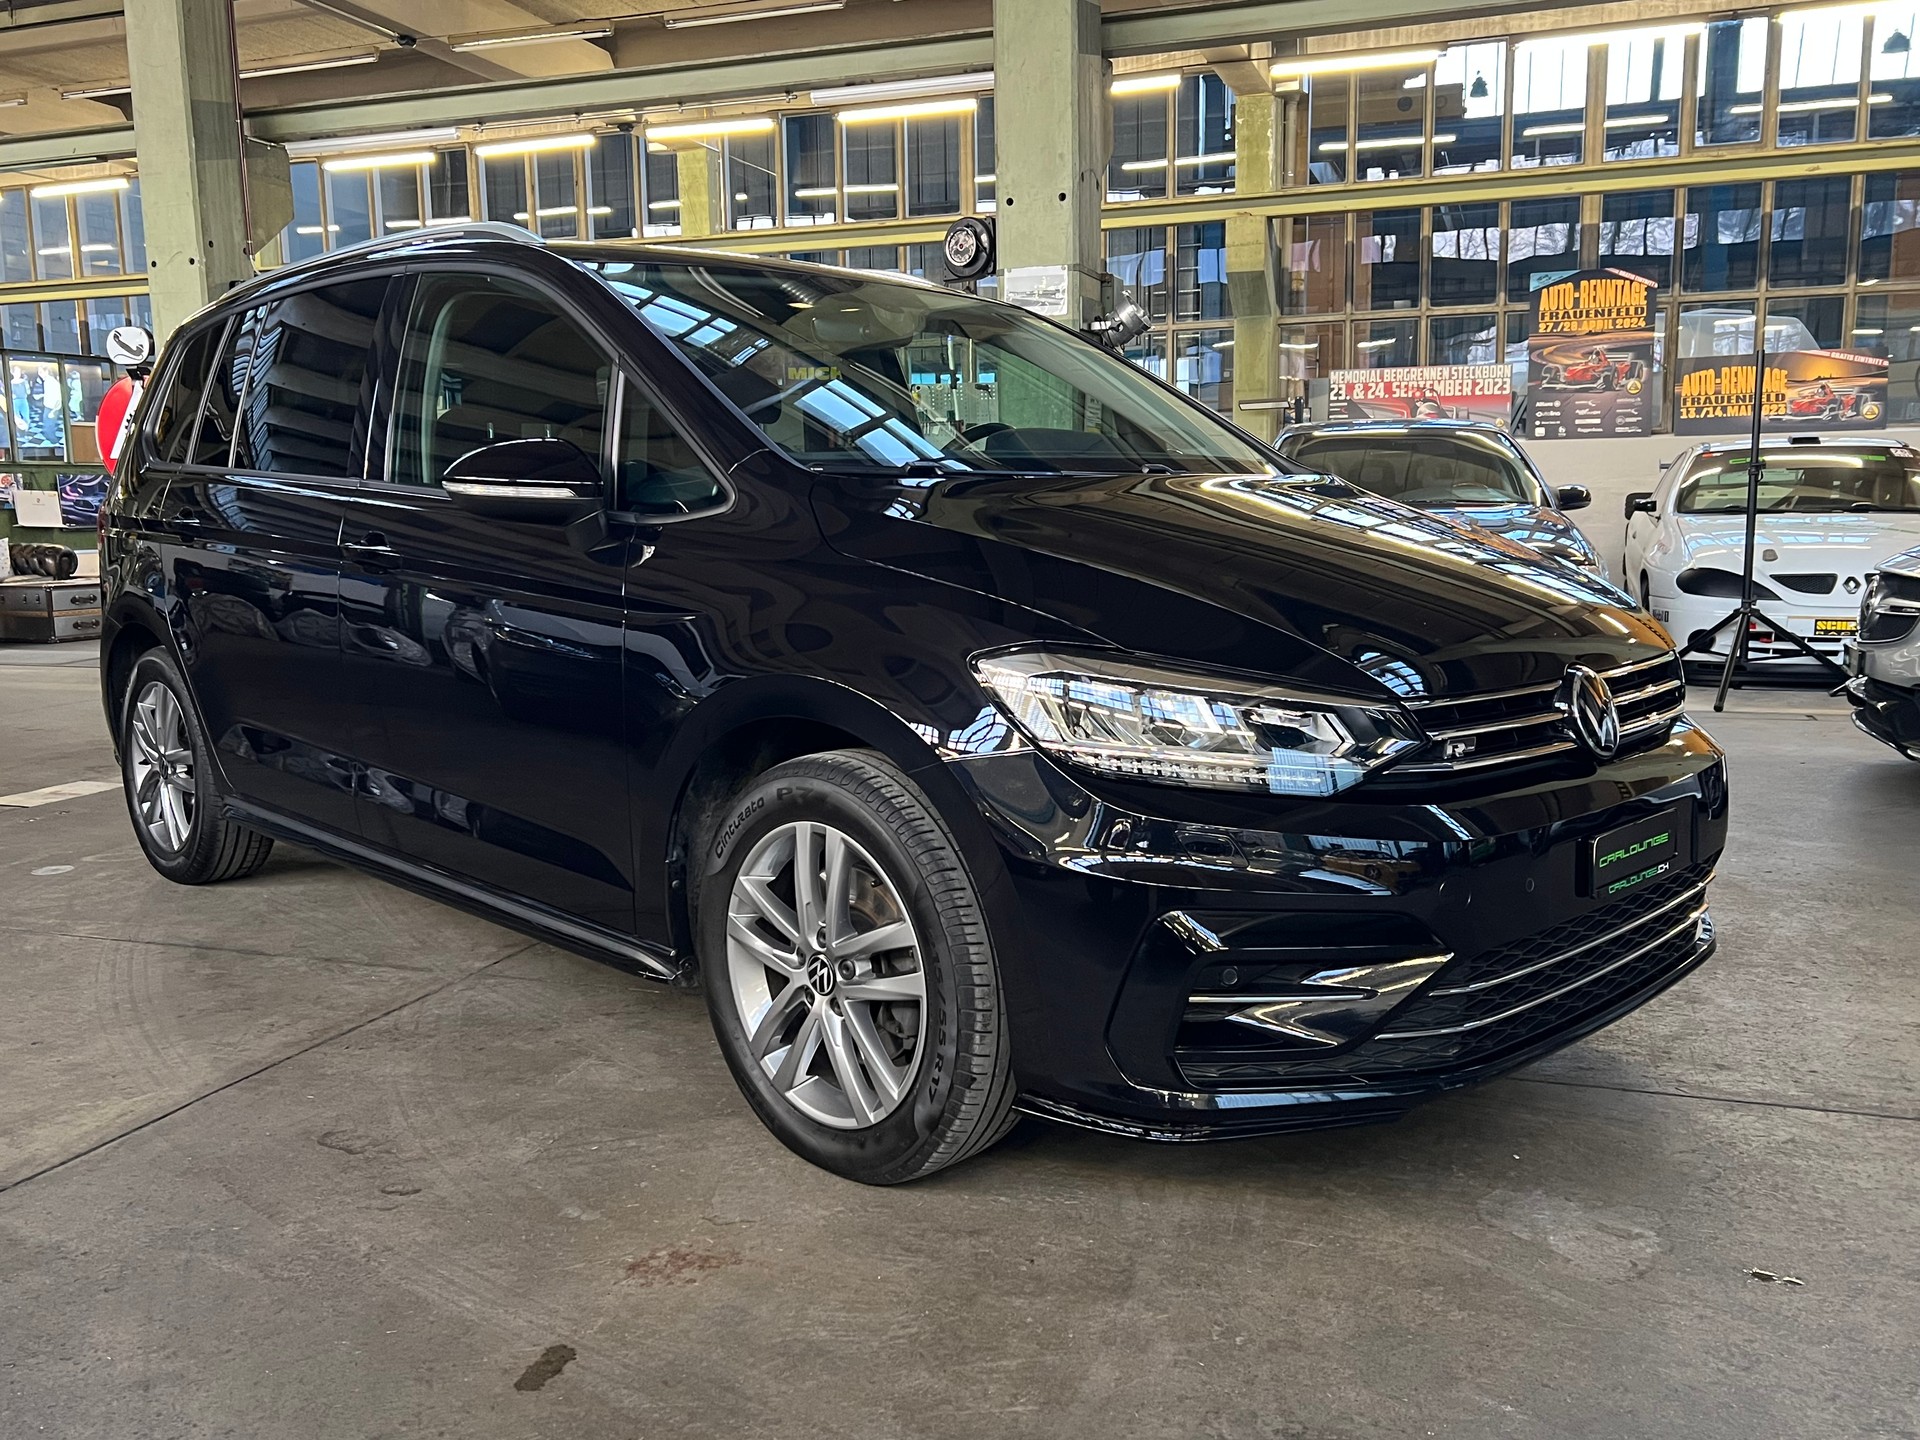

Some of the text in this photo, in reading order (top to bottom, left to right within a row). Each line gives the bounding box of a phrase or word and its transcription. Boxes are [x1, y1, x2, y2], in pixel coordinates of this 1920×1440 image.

[1540, 279, 1648, 311] AUTO-RENNTAGE
[1540, 306, 1645, 321] FRAUENFELD
[1616, 317, 1646, 328] 2024
[1330, 365, 1511, 384] MEMORIAL BERGRENNEN STECKBORN
[1330, 384, 1351, 400] 23.
[1353, 383, 1365, 398] &
[1367, 382, 1388, 399] 24.
[1475, 378, 1510, 396] 2023
[1682, 365, 1788, 396] AUTO-RENNAGE
[715, 796, 765, 859] Cinturato
[1599, 832, 1669, 868] CARLOUNGE
[1608, 862, 1669, 894] CARLOUNGE.CH
